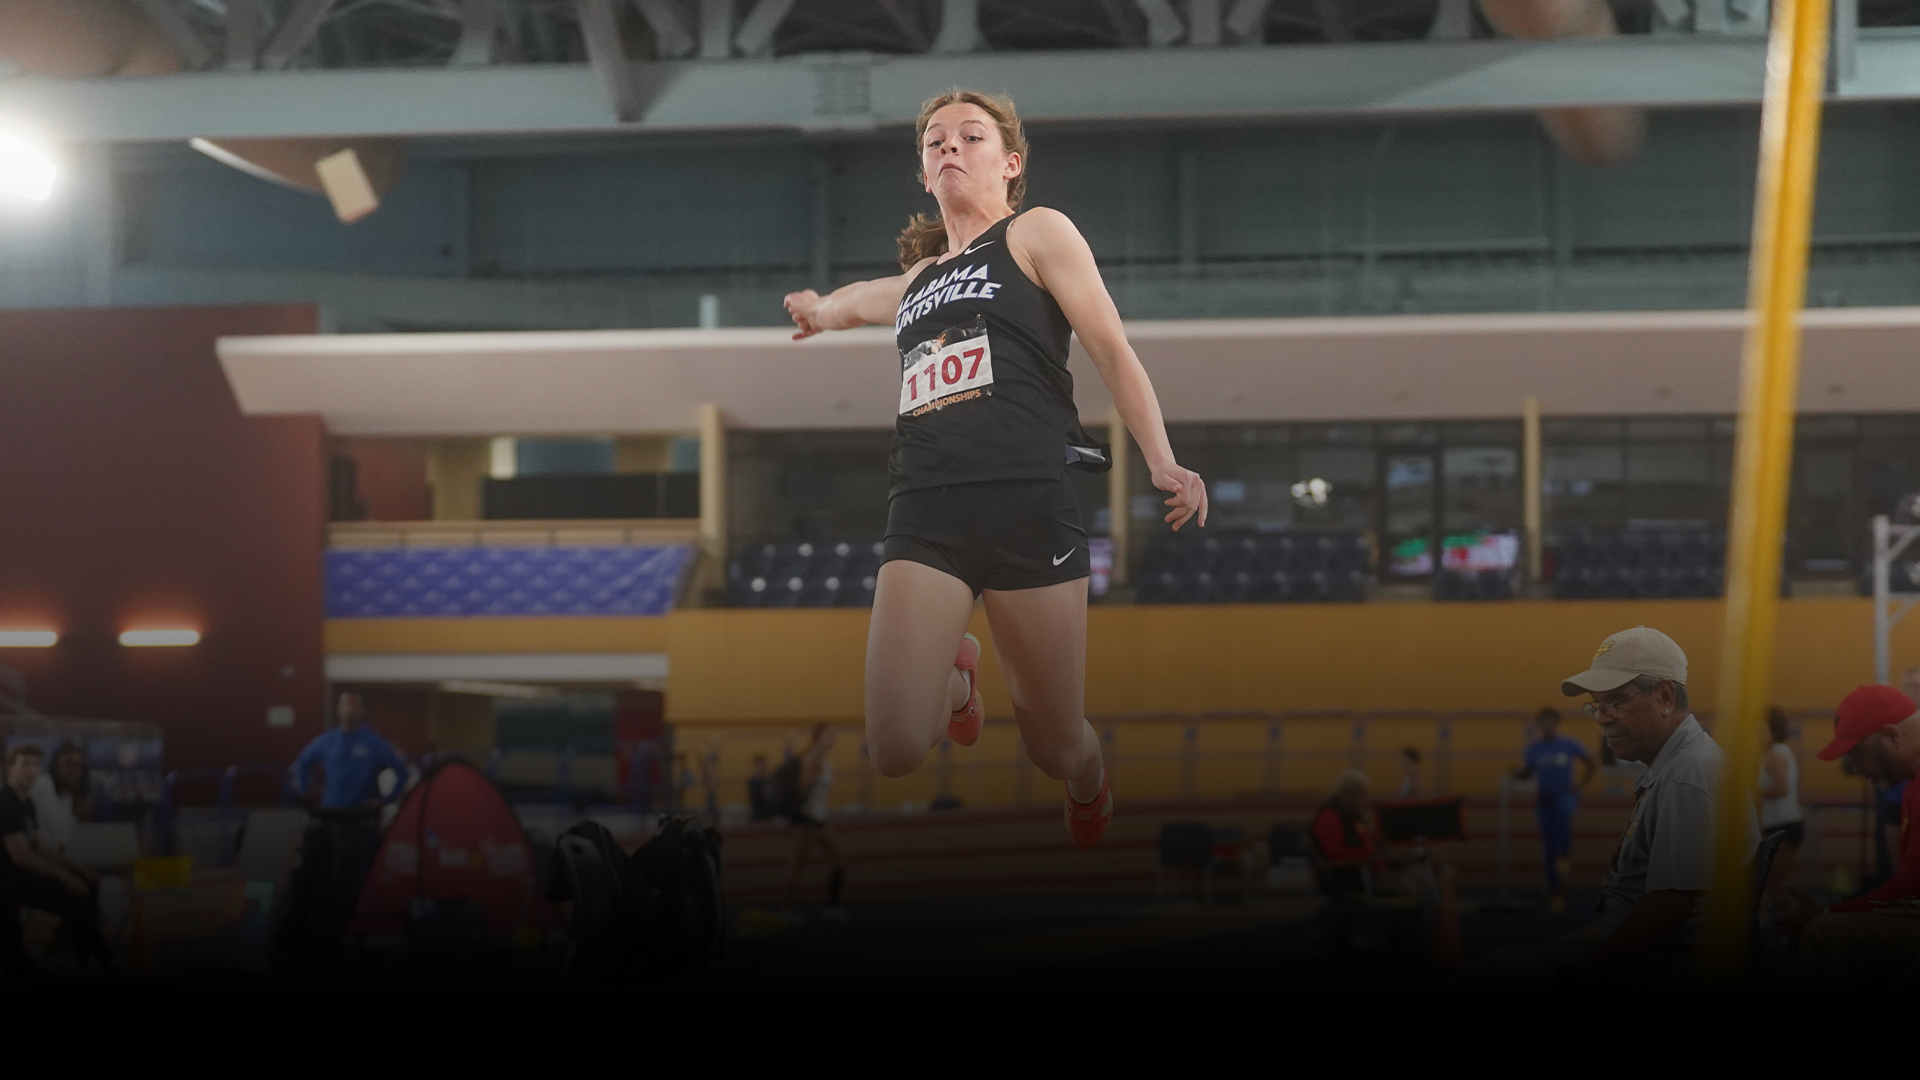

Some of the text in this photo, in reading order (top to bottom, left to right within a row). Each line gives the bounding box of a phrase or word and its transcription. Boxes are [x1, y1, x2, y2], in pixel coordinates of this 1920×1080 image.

[895, 281, 1002, 335] UNTSVILLE
[907, 347, 985, 401] 1107
[913, 389, 981, 417] CHAMPIONSHIPS
